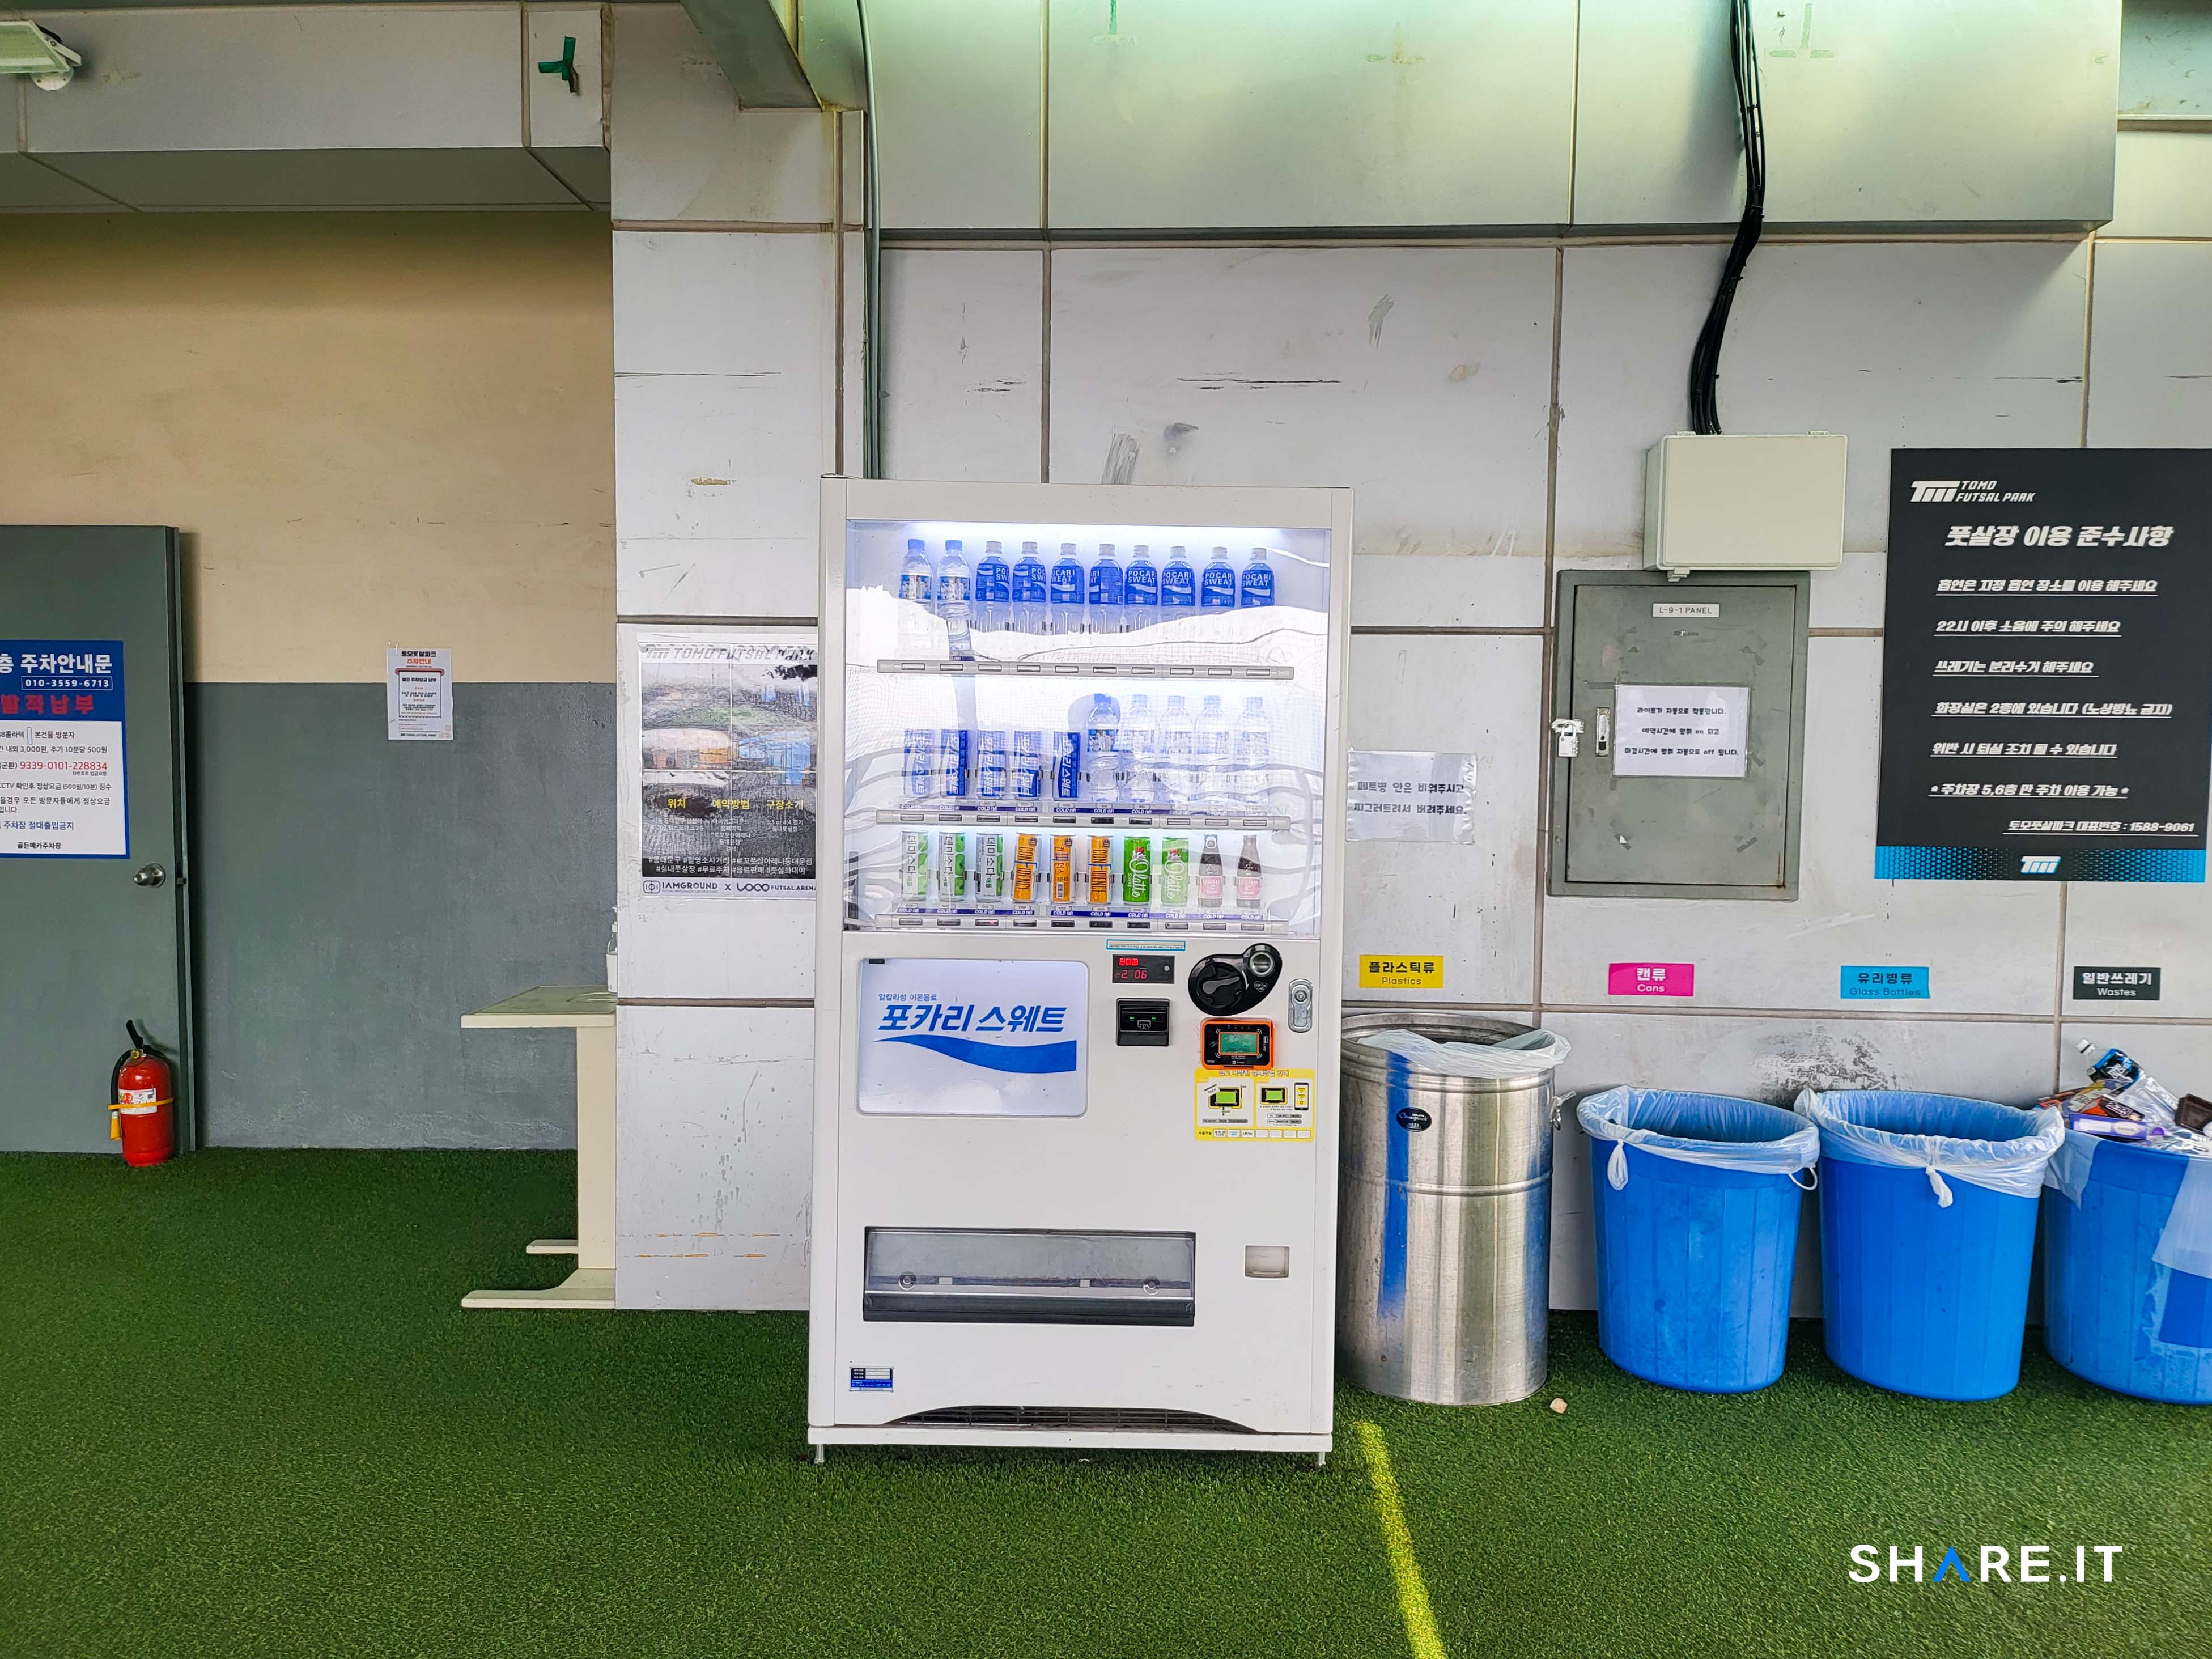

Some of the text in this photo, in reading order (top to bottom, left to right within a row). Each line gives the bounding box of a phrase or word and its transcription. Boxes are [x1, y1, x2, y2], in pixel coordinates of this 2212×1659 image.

[1961, 481, 1997, 490] TOMO
[1955, 493, 2036, 502] FUTSAL PARK
[1944, 525, 2174, 547] 풋살장 이용 준수사항
[1937, 579, 2158, 592] 흡연은 지정 흡연 장소를 이용 해주세요
[1935, 620, 2121, 633] 22시 이후 소음에 주의 해주세요
[20, 654, 112, 674] 주차안내문
[1934, 661, 2095, 673] 쓰레기는 분리수거 해주세요
[25, 679, 109, 688] 010-3559-6713
[1935, 702, 2173, 715] 화장실은 2층에 있습니다 (노상방뇨 금지)
[1932, 742, 1959, 754] 위반
[1960, 743, 1975, 754] 시
[1977, 743, 2004, 754] 퇴실
[2005, 743, 2032, 755] 조치
[2049, 744, 2064, 755] 수
[2066, 744, 2118, 756] 있습니다
[20, 761, 108, 770] 9339-0101-228834
[1357, 782, 1464, 794] 페트병 안은 비워주시고
[1941, 784, 1980, 795] 주차장
[2035, 784, 2062, 796] 주차
[2064, 784, 2090, 796] 이용
[2091, 785, 2118, 796] 가능
[668, 798, 687, 809] 위치
[712, 799, 750, 810] 예약방법
[766, 800, 804, 810] 구장소개
[1353, 803, 1467, 815] 찌그러트려서 버려주세요.
[4, 821, 74, 830] 주차장 절대출입금지
[2007, 820, 2194, 833] 토모풋살파크 대표번호 1588-9061
[907, 835, 916, 875] 데미소다
[944, 836, 953, 876] 데미소다
[986, 837, 996, 877] 데미소다
[766, 866, 805, 875] #풋살화대여
[1369, 962, 1434, 973] 플라스틱류
[1637, 968, 1666, 982] 캔류
[1858, 973, 1912, 985] 유리병류
[2082, 972, 2152, 985] 일반쓰레기
[1637, 983, 1665, 992] Cans
[1850, 987, 1921, 996] Glass Bottles
[2098, 988, 2137, 996] Wastes
